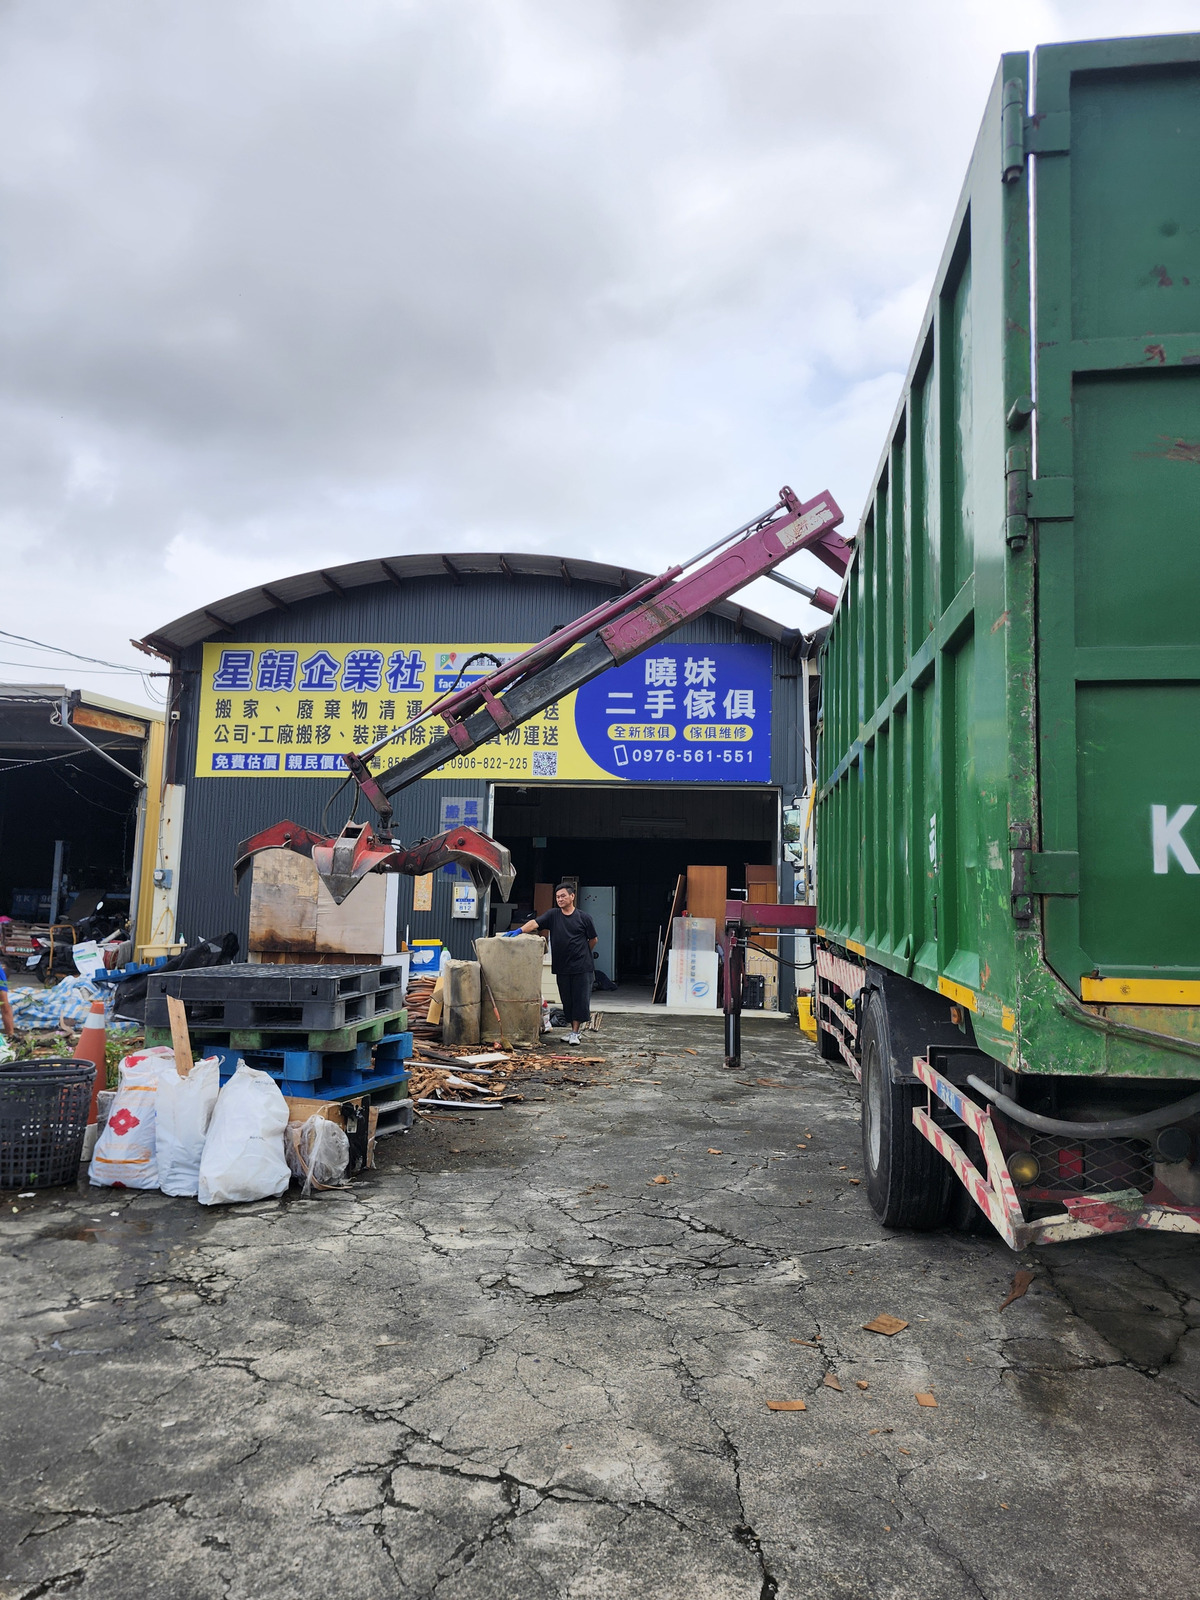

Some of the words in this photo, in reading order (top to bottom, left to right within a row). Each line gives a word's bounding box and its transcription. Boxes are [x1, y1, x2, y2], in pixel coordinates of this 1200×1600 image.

[212, 648, 426, 693] 星韻企業社
[645, 656, 717, 688] 曉妹
[605, 688, 757, 721] 二手傢俱
[613, 725, 671, 739] 全新傢俱
[689, 726, 747, 740] 傢俱維修
[214, 754, 278, 771] 免費估價
[632, 748, 753, 763] 0976-561-551
[1151, 804, 1200, 875] K
